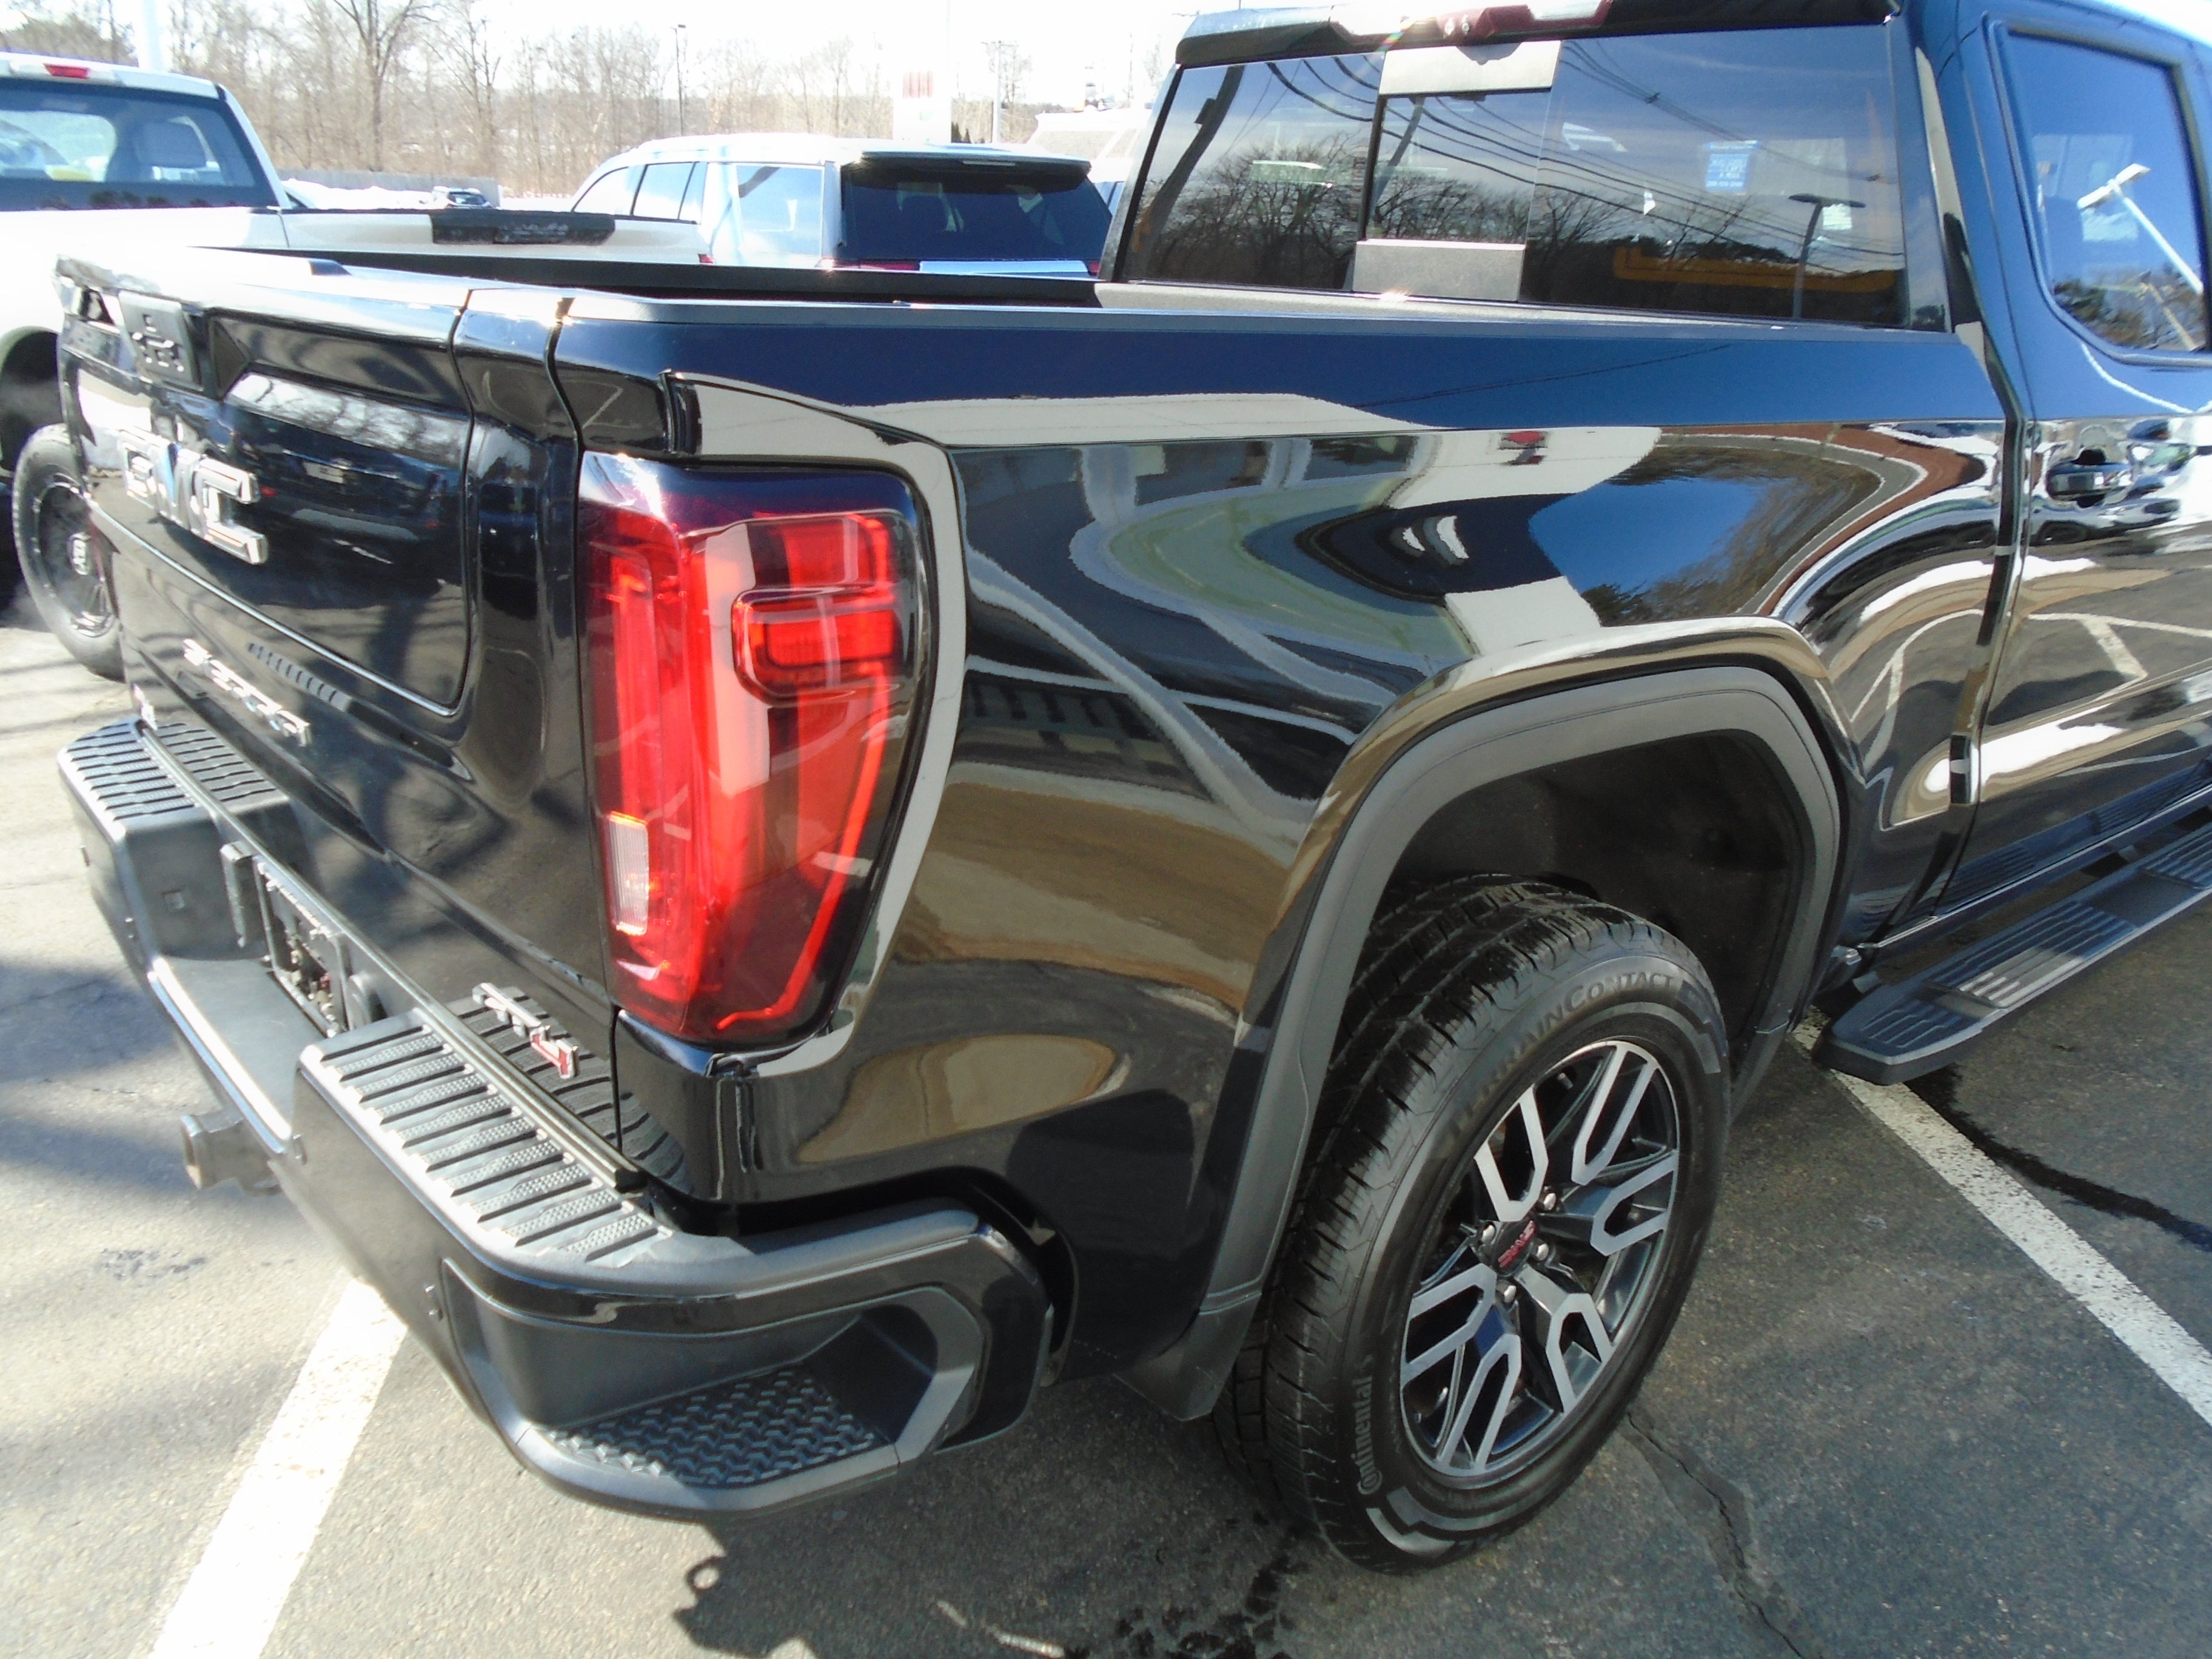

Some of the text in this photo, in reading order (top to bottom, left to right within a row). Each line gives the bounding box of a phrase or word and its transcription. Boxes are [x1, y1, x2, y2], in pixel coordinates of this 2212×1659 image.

[116, 423, 269, 565] GMC
[472, 982, 579, 1079] AT4
[1498, 1219, 1537, 1268] GMC
